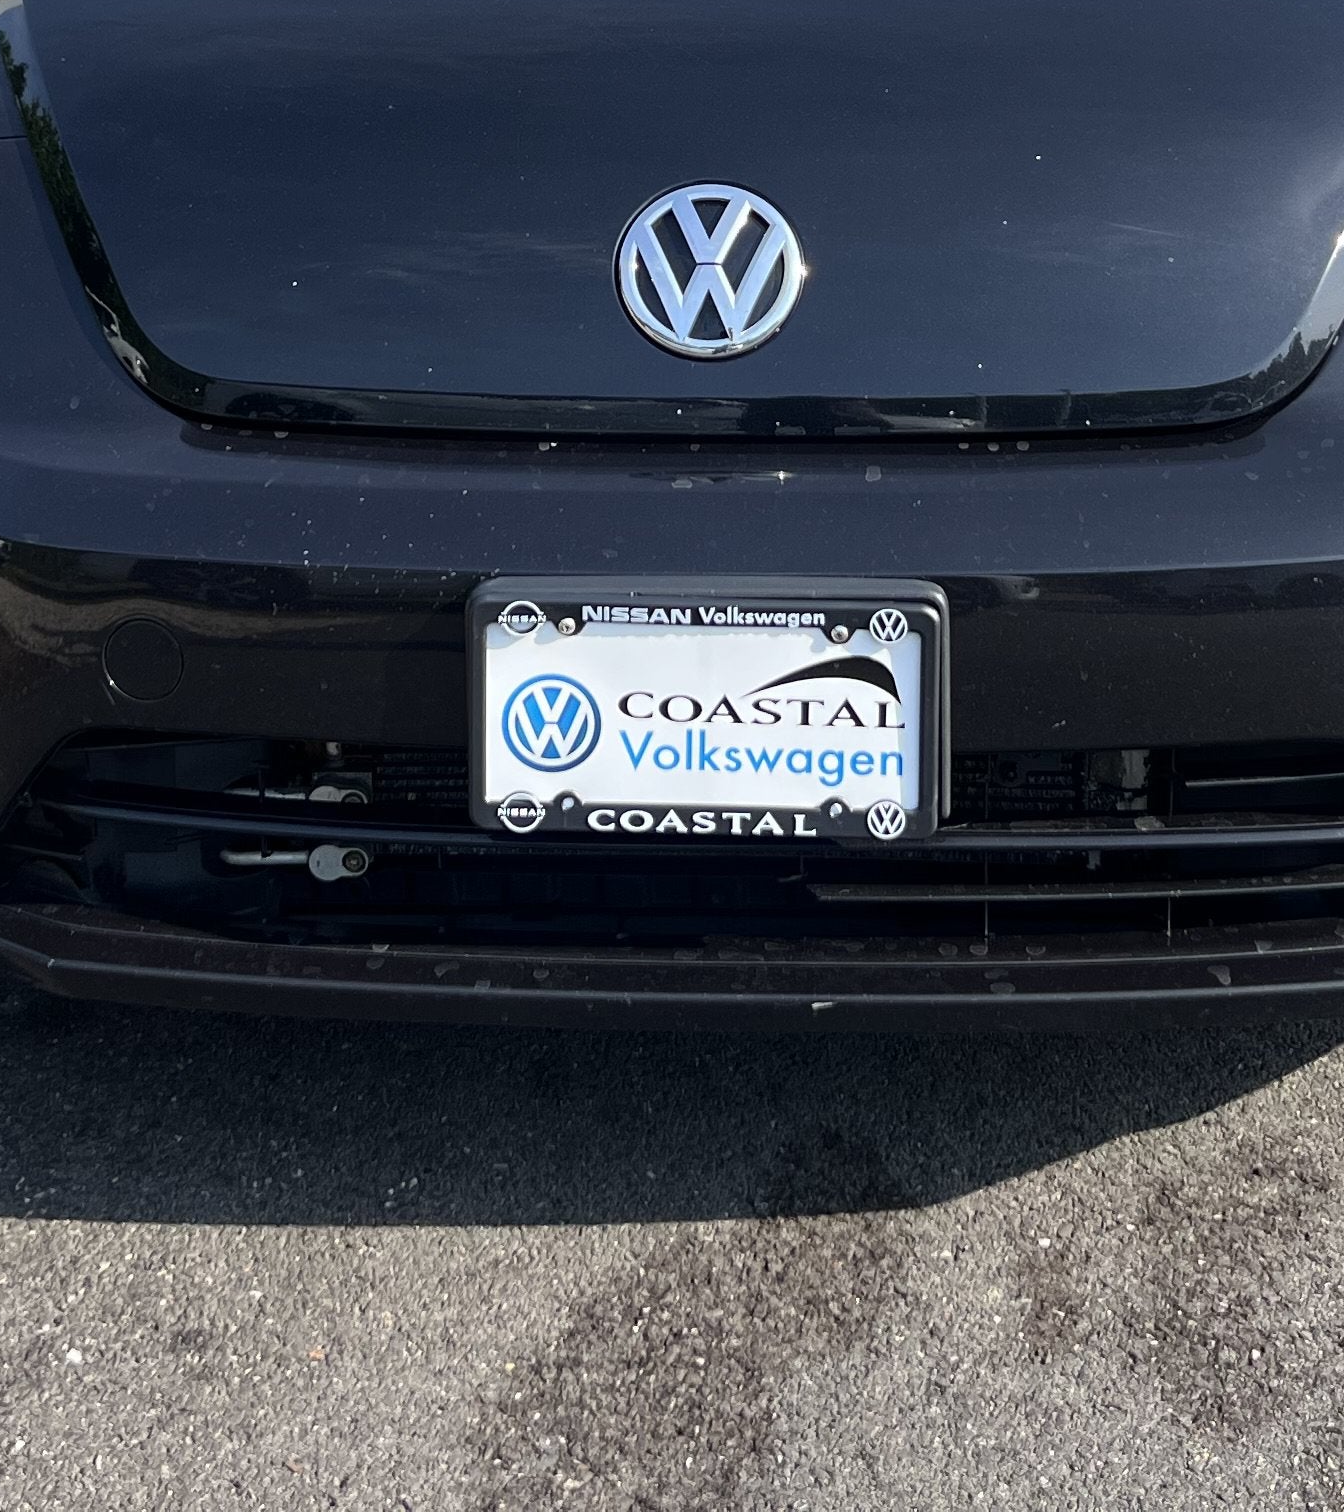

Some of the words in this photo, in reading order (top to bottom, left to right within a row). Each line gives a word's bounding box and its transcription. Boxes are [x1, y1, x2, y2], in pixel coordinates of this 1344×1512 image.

[613, 180, 805, 362] VW
[497, 614, 547, 624] NISSAN
[582, 605, 691, 625] NISSAN
[698, 606, 825, 628] Volkswagen
[502, 673, 601, 772] VW
[618, 691, 905, 729] COASTAL
[619, 728, 903, 786] Volkswagen
[497, 807, 545, 818] NISSAN
[587, 809, 817, 837] COASTAL
